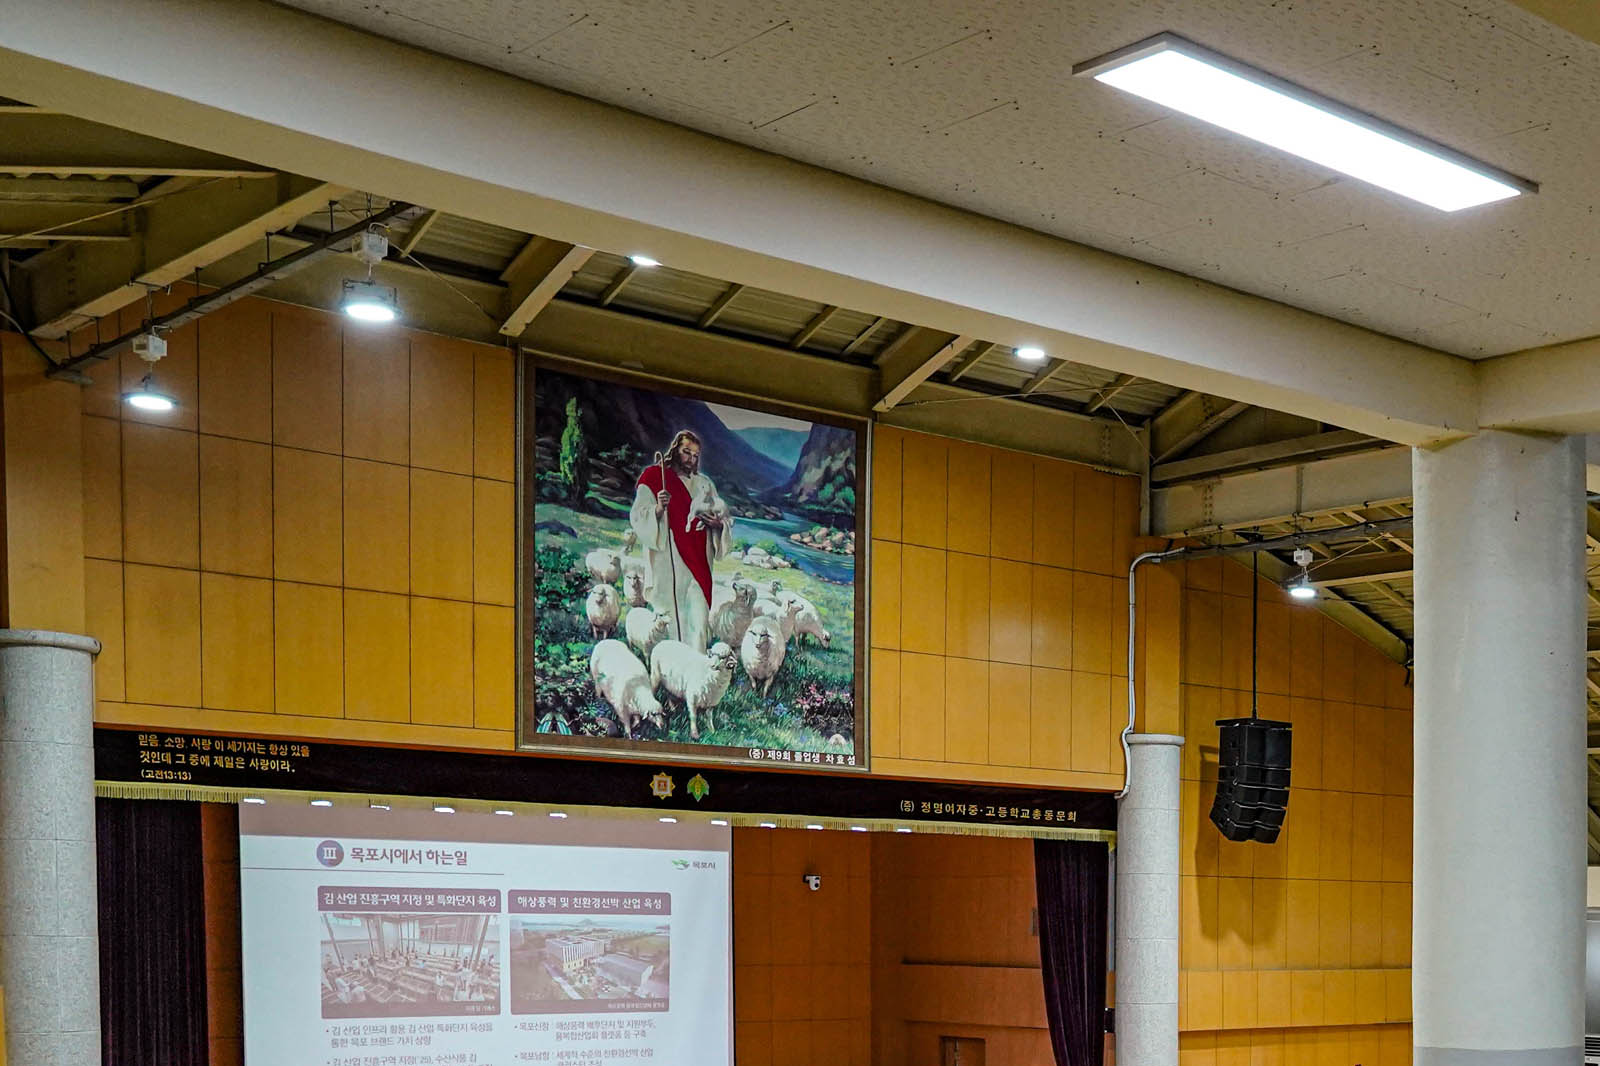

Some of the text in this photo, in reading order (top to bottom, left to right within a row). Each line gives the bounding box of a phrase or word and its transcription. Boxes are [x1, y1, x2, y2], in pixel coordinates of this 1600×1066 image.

[192, 737, 212, 750] 사랑
[215, 738, 224, 751] 이
[270, 744, 288, 756] 항상
[291, 745, 310, 758] 있을
[140, 750, 296, 772] 것인데 그 중에 제일은 사랑이라.
[749, 748, 764, 760] (증)
[767, 750, 790, 762] 제9회
[794, 752, 820, 763] 졸업생
[140, 769, 192, 780] (고전13:13)
[900, 800, 914, 812] (증)
[350, 847, 422, 864] 목포시에서
[426, 848, 468, 866] 하는일
[324, 893, 496, 908] 김 산업 진흥구역 지정 및 특화단지 육성
[517, 896, 662, 910] 해상풍력 및 친환경선박 산업 육성
[344, 1025, 360, 1036] 산업
